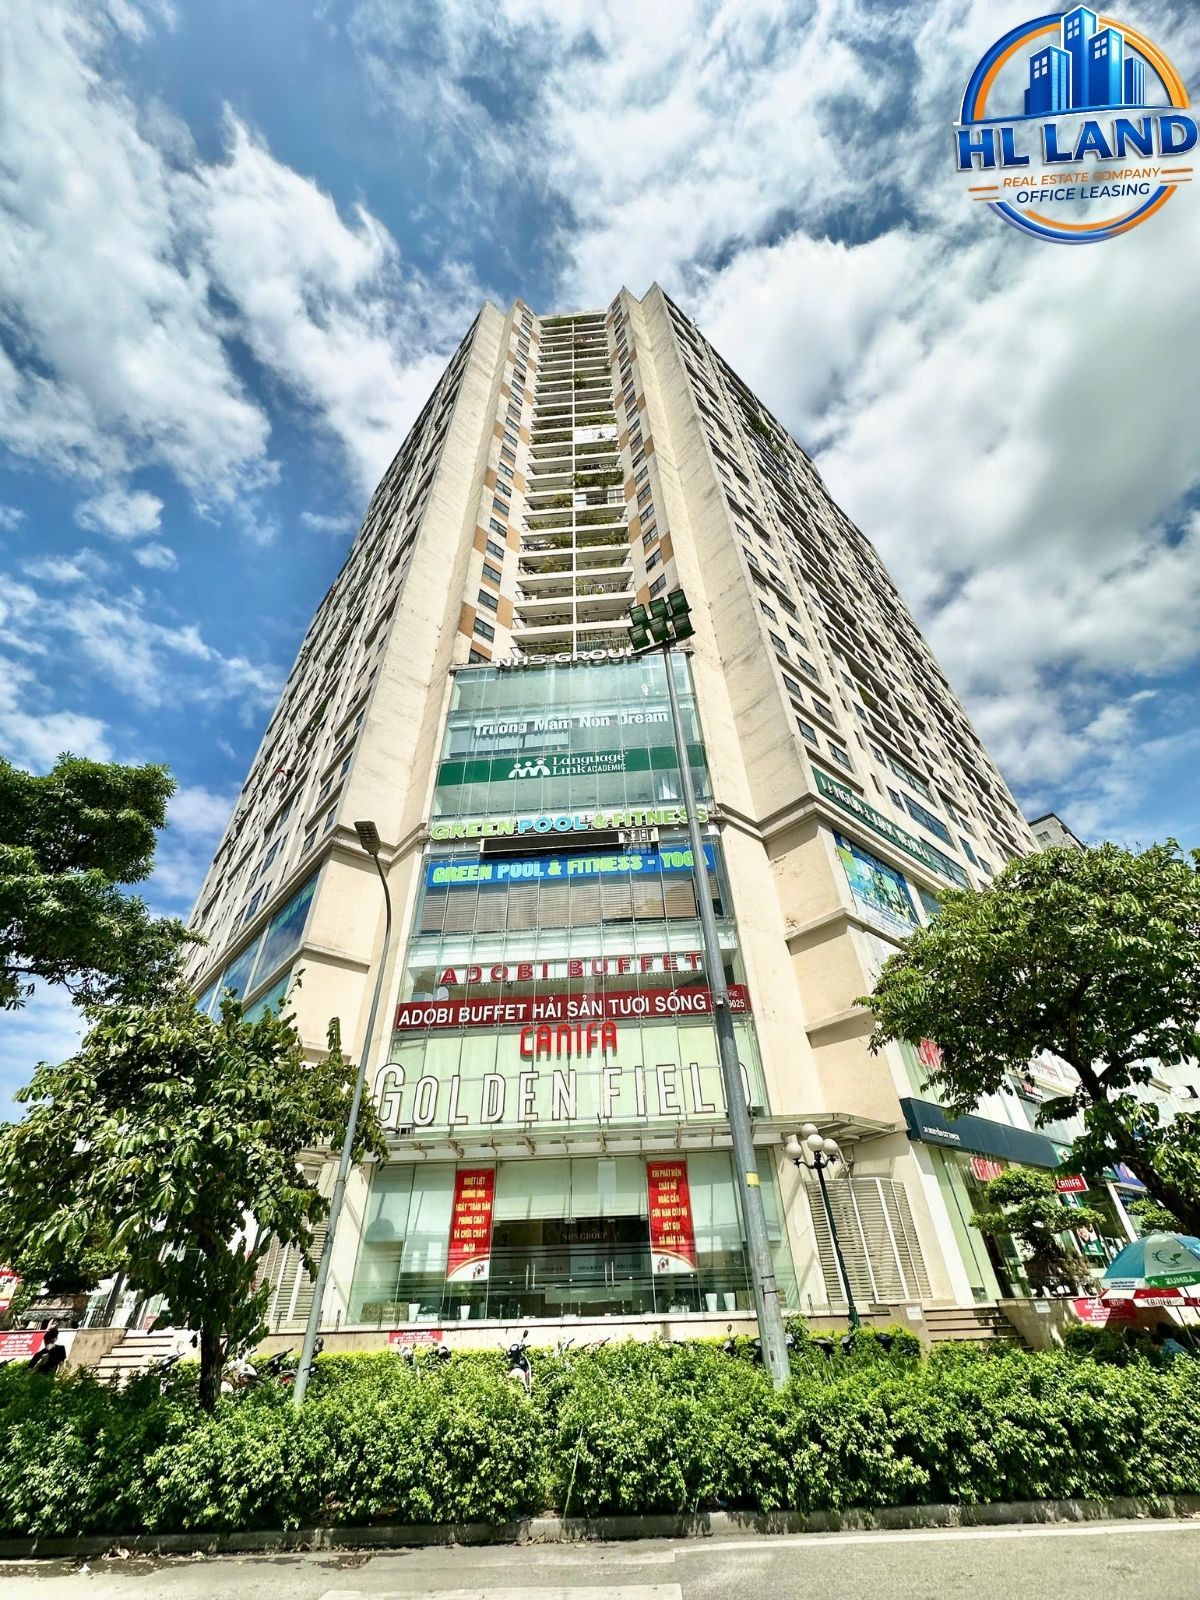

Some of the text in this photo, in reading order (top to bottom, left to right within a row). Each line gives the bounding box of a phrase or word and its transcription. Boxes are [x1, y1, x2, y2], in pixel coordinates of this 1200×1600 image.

[495, 653, 546, 668] NHS
[579, 714, 610, 728] Non
[618, 711, 669, 725] Dream
[552, 753, 626, 766] Language
[552, 763, 627, 775] Link ACADEMIC
[430, 807, 709, 841] GREEN POOL & FITNESS
[432, 864, 493, 883] GREEN
[497, 861, 544, 879] POOL
[547, 860, 562, 875] &
[567, 855, 643, 874] FITNESS
[660, 850, 709, 868] YOG
[439, 951, 702, 985] ADOBI BUFFET
[398, 989, 706, 1026] ADOBI BUFFET HẢI SẢN TƯƠI SỐNG
[520, 1021, 618, 1059] CANIFA
[372, 1062, 577, 1131] GOLDEN
[1056, 1178, 1081, 1189] CANIFA
[1165, 1275, 1196, 1285] ZUMBA
